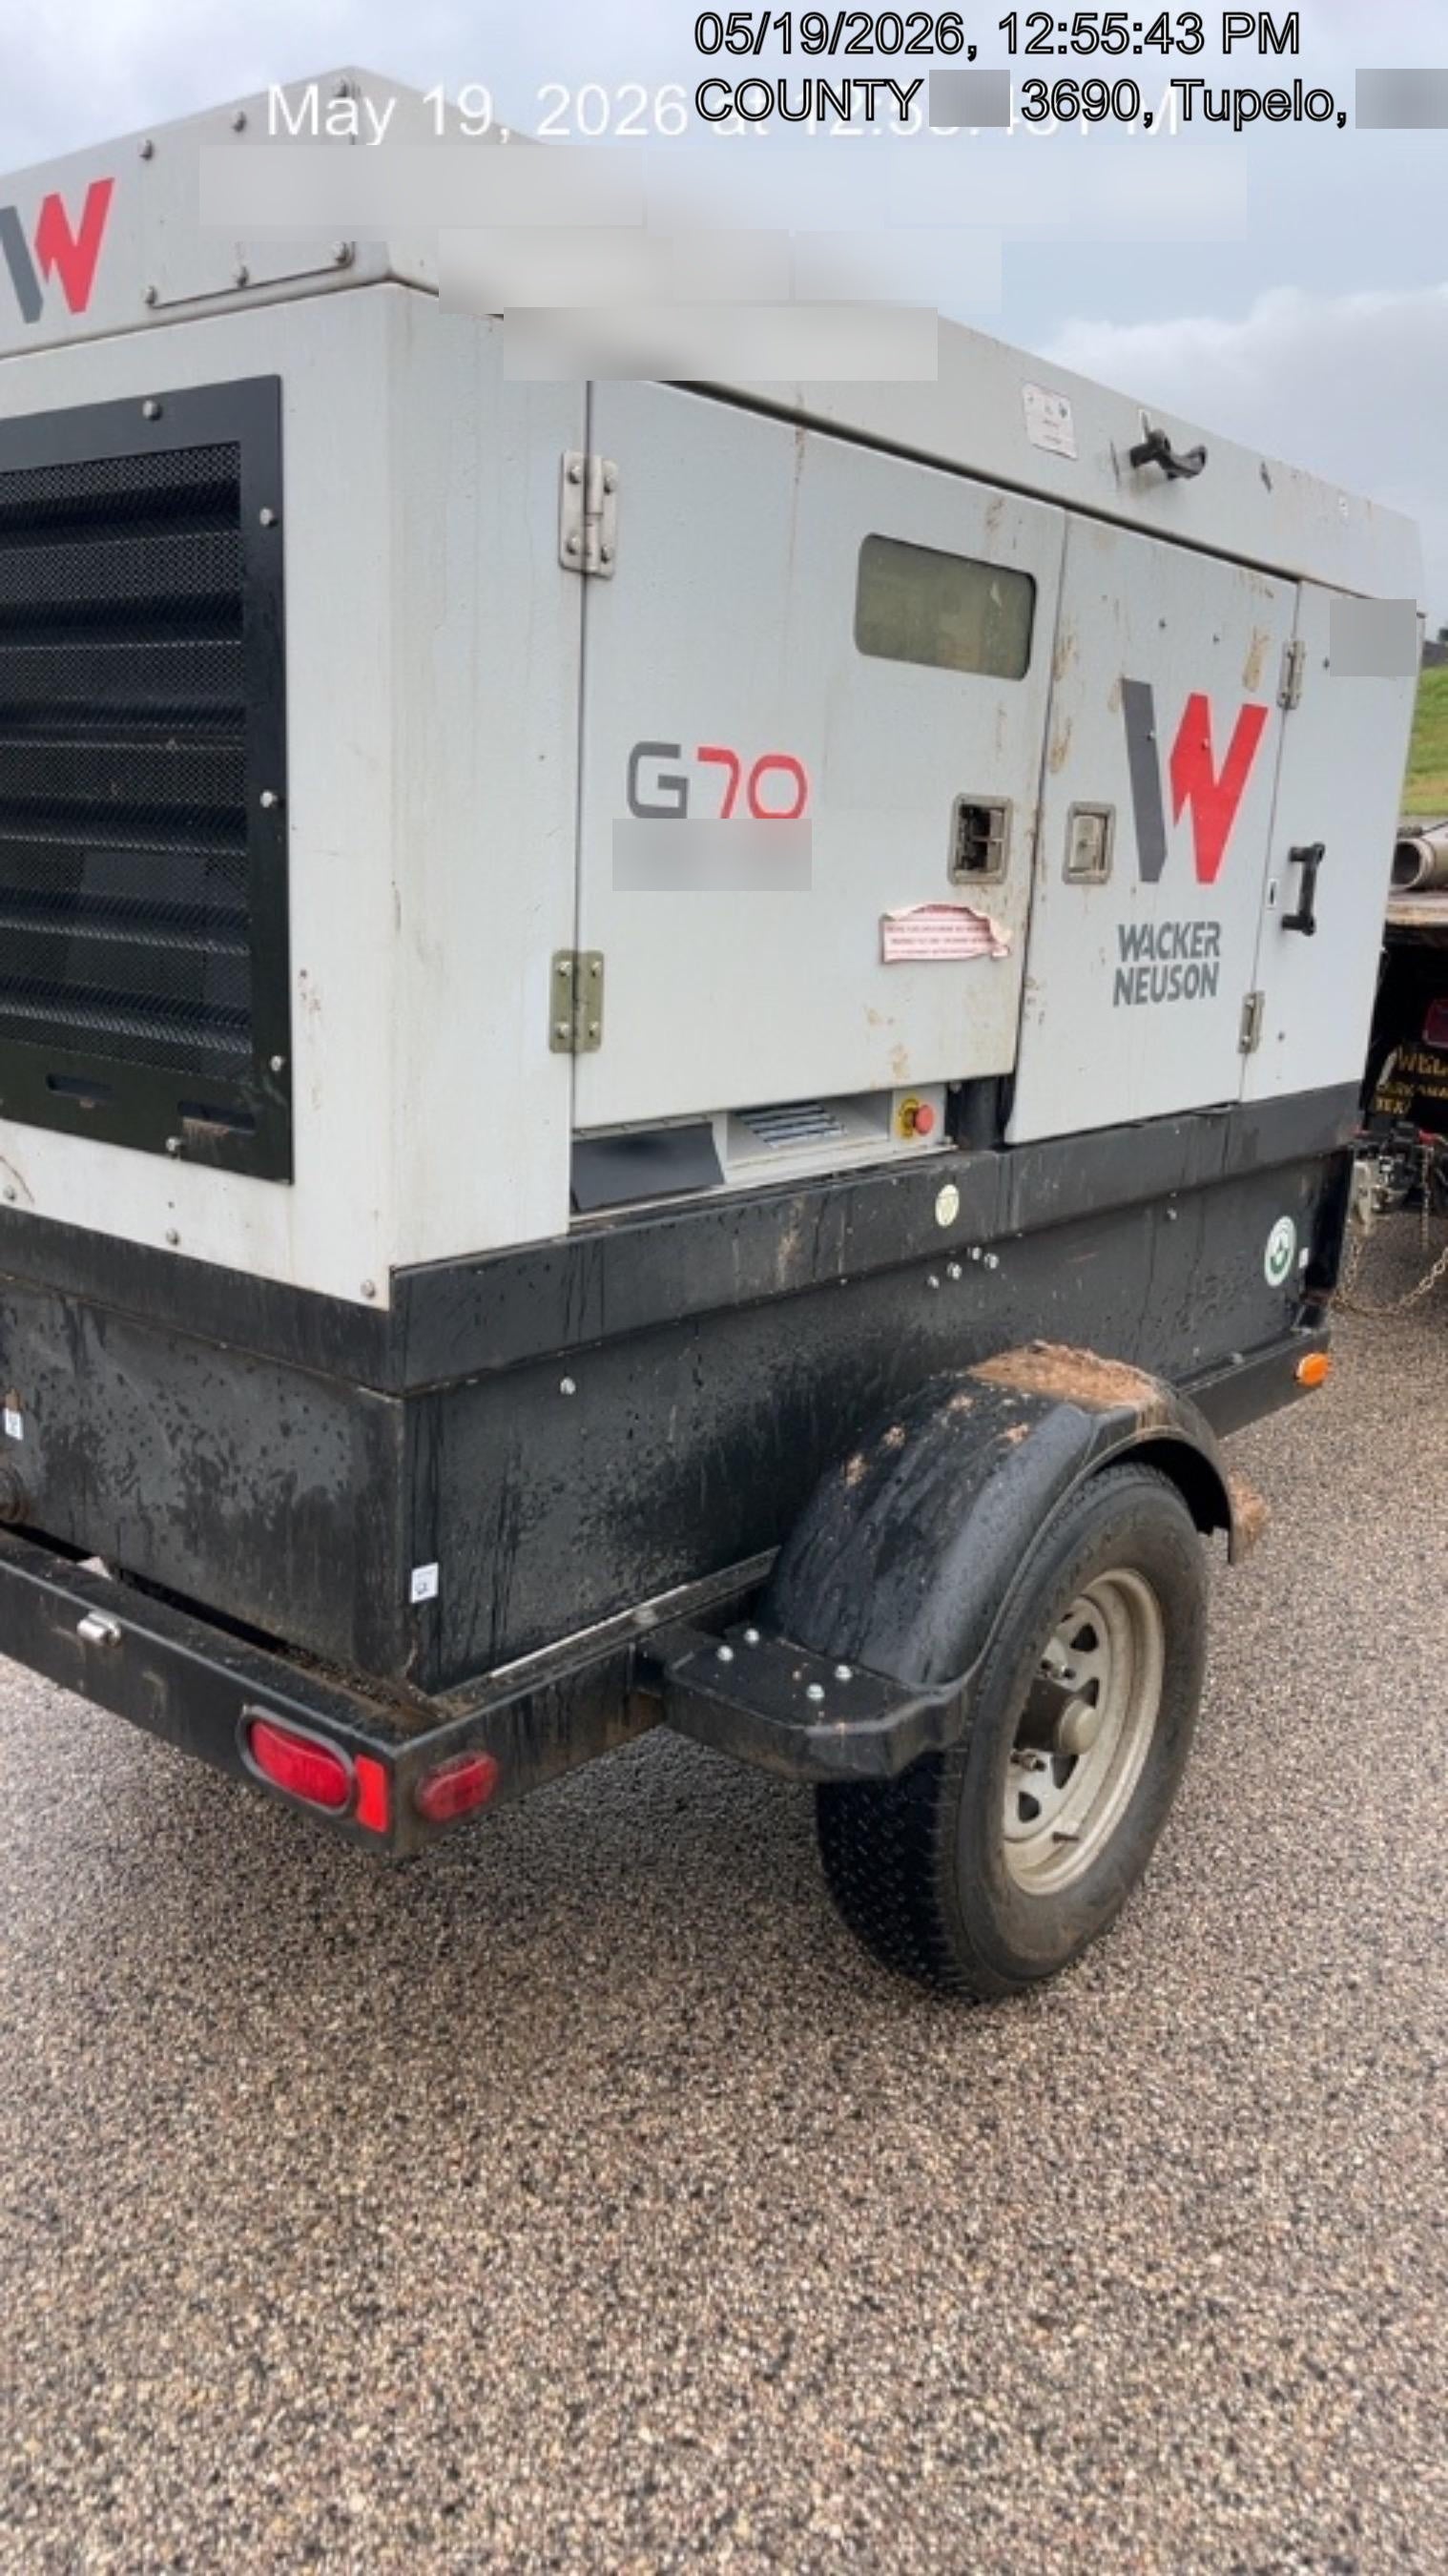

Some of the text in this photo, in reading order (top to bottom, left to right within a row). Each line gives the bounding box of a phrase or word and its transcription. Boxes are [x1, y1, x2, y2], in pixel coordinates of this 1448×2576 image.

[627, 740, 809, 819] G70
[1118, 922, 1222, 963] WACKER
[1112, 963, 1220, 1008] NEUSON
